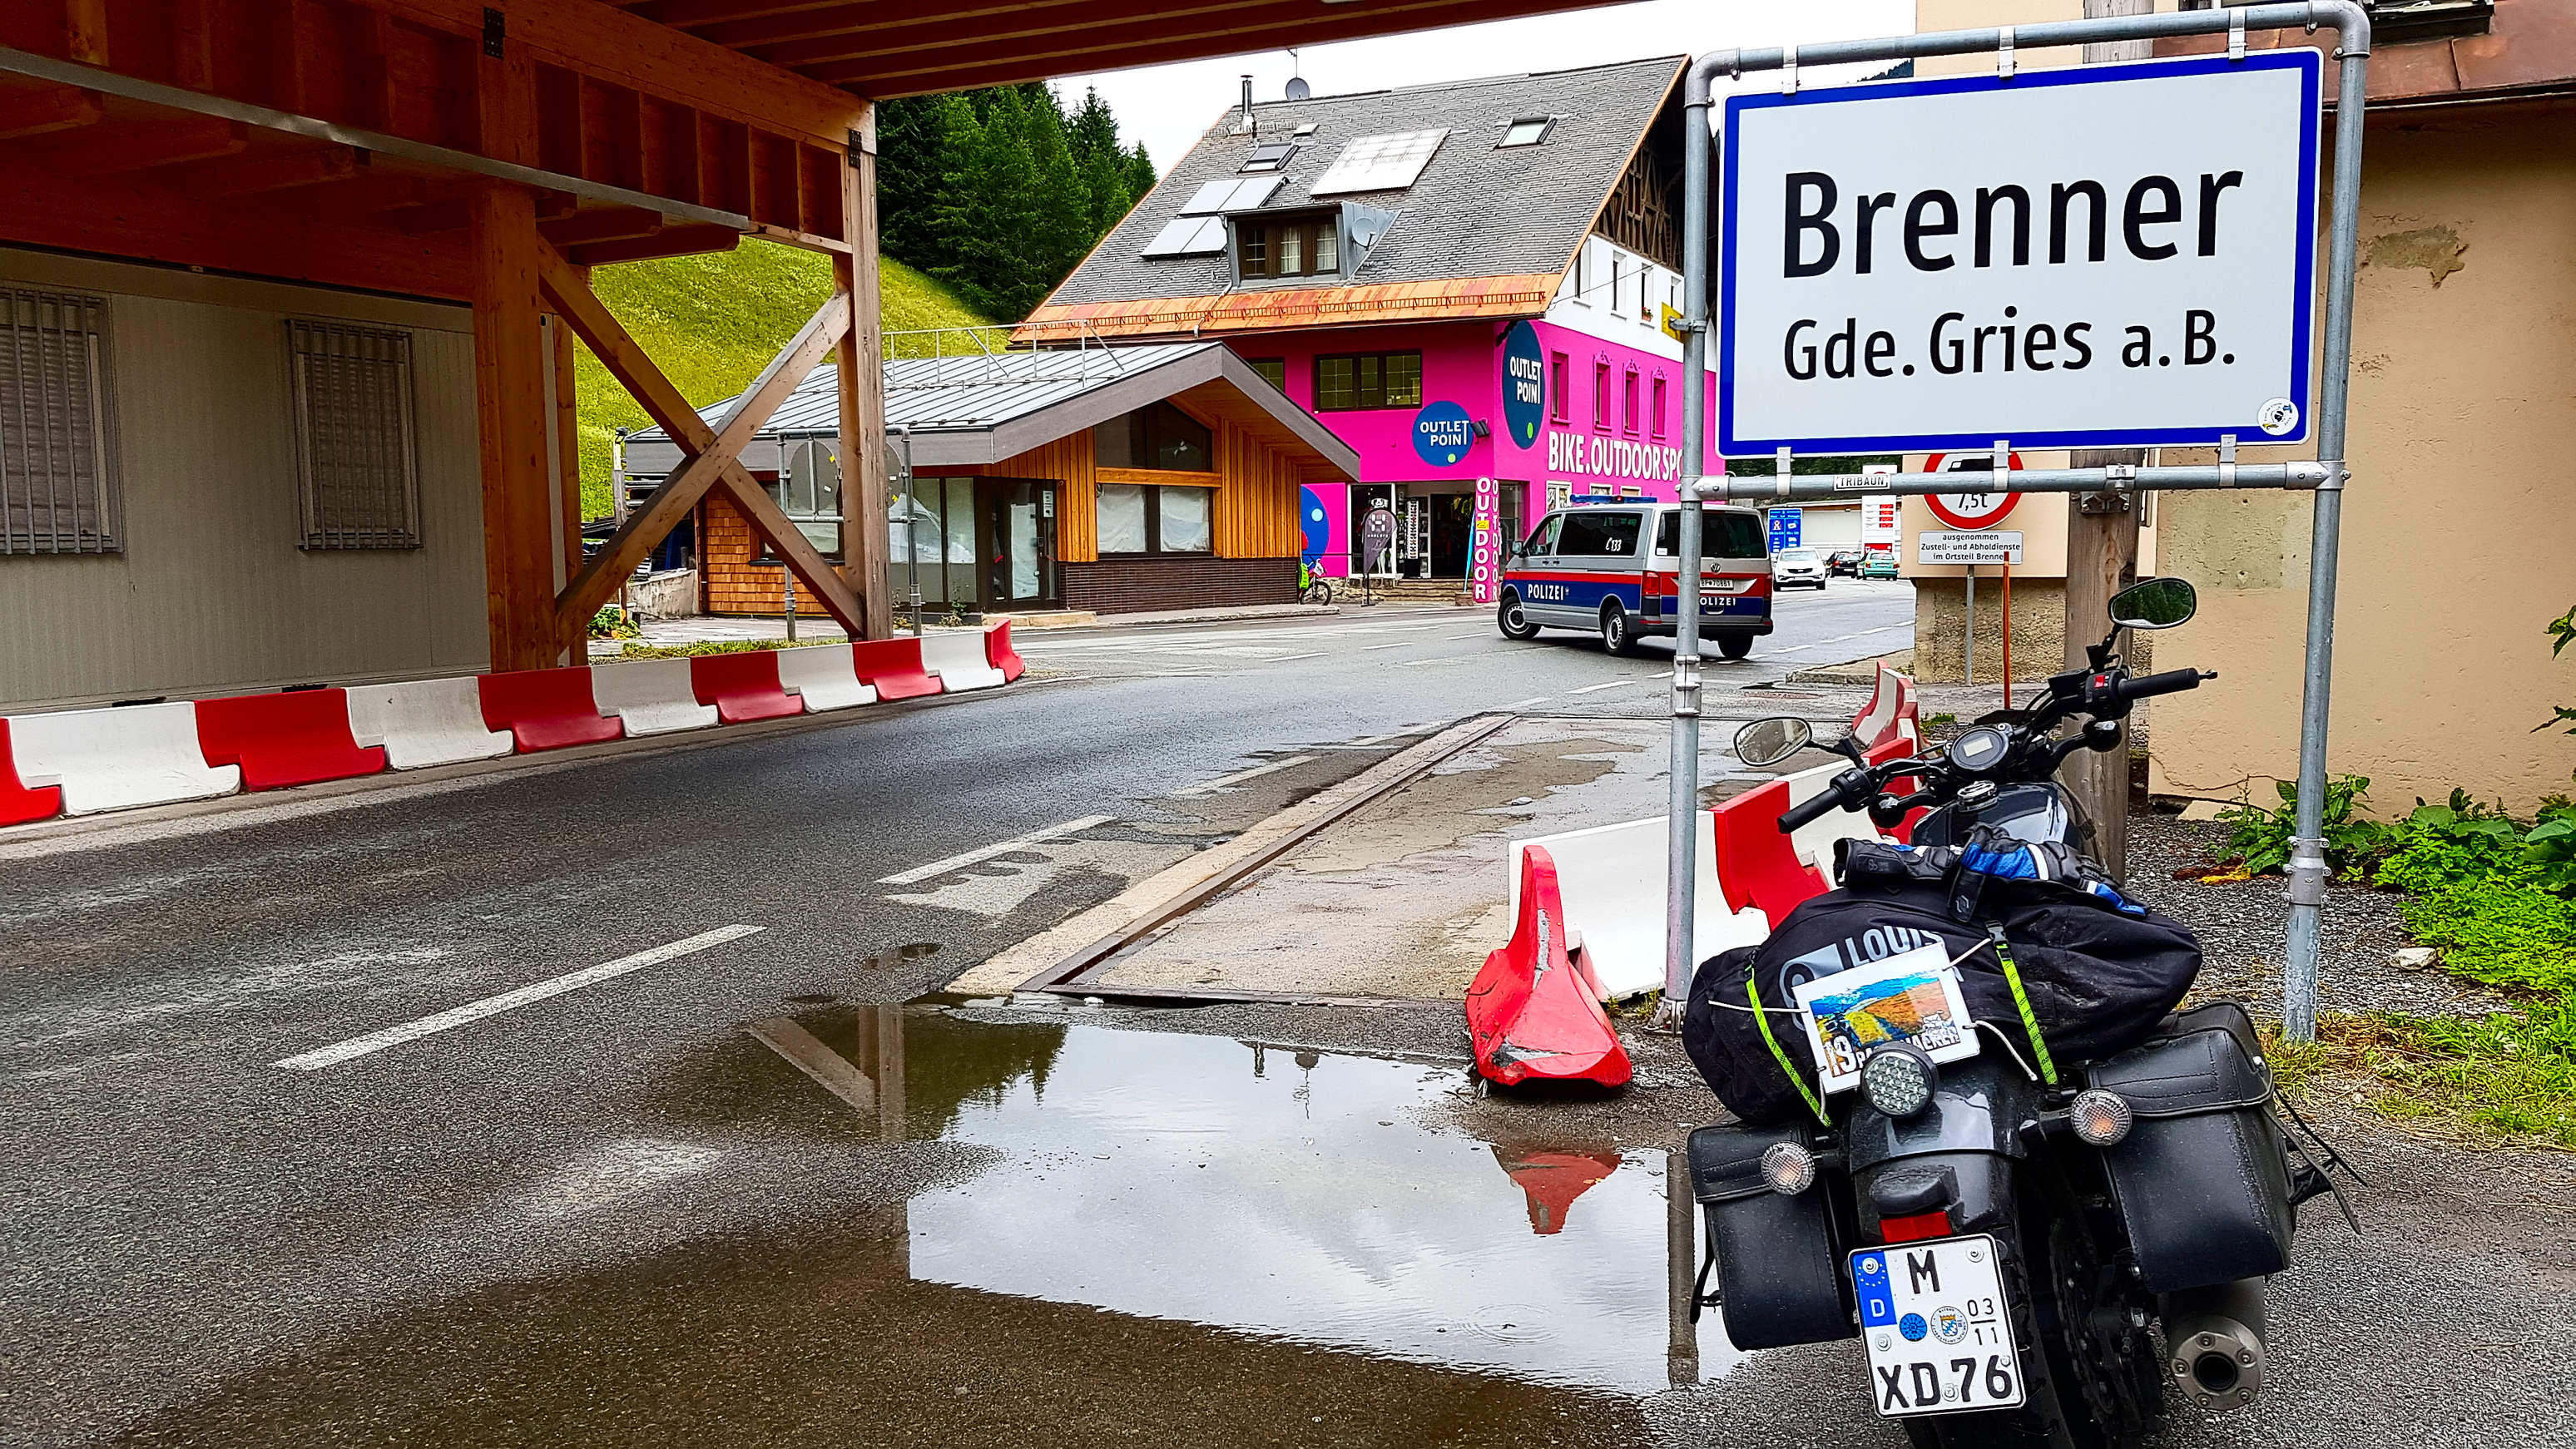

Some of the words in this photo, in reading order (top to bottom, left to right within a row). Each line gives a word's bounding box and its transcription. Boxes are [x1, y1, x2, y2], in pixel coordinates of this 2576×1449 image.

[1784, 171, 2243, 278] Brenner
[1785, 318, 1914, 379] Gde.
[1930, 306, 2092, 374] Gries
[1510, 356, 1541, 380] OUTLET
[1517, 381, 1541, 404] POINT
[1419, 420, 1469, 433] OUTLET
[1430, 433, 1468, 446] POINT
[1662, 446, 1683, 482] SPO
[1840, 477, 1884, 486] TRIBAUN
[1474, 477, 1491, 599] OUTDOOR
[1611, 539, 1622, 551] 133
[1528, 583, 1563, 601] POLIZEI
[1699, 597, 1736, 606] OLIZEI
[1907, 1250, 1940, 1294] M
[1870, 1298, 1885, 1318] D
[1967, 1298, 1994, 1317] 03
[1975, 1327, 1998, 1345] 11
